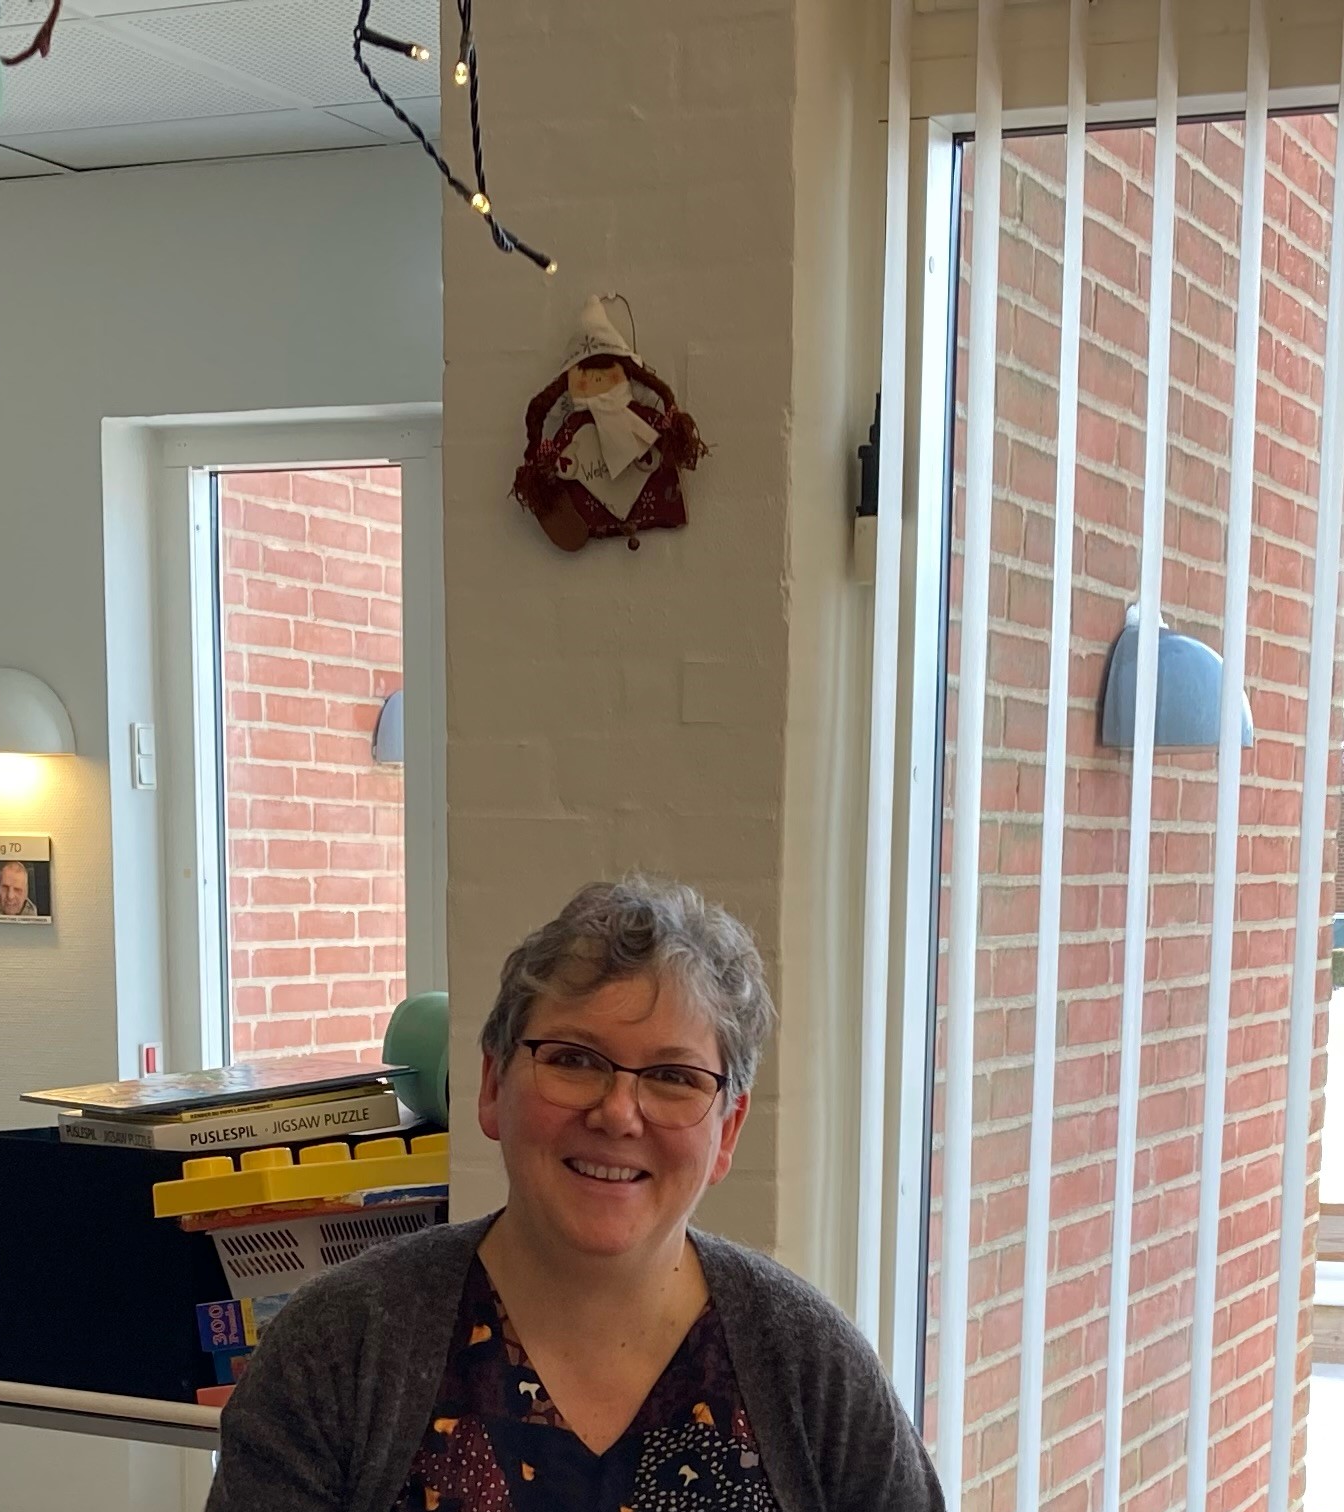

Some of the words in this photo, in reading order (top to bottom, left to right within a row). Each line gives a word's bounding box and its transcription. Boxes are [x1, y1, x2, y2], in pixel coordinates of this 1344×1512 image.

[9, 843, 22, 853] 7D
[189, 1124, 258, 1147] PUSLESPIL
[272, 1115, 321, 1135] JIGSAW
[323, 1107, 370, 1127] PUZZLE
[208, 1304, 228, 1346] 300
